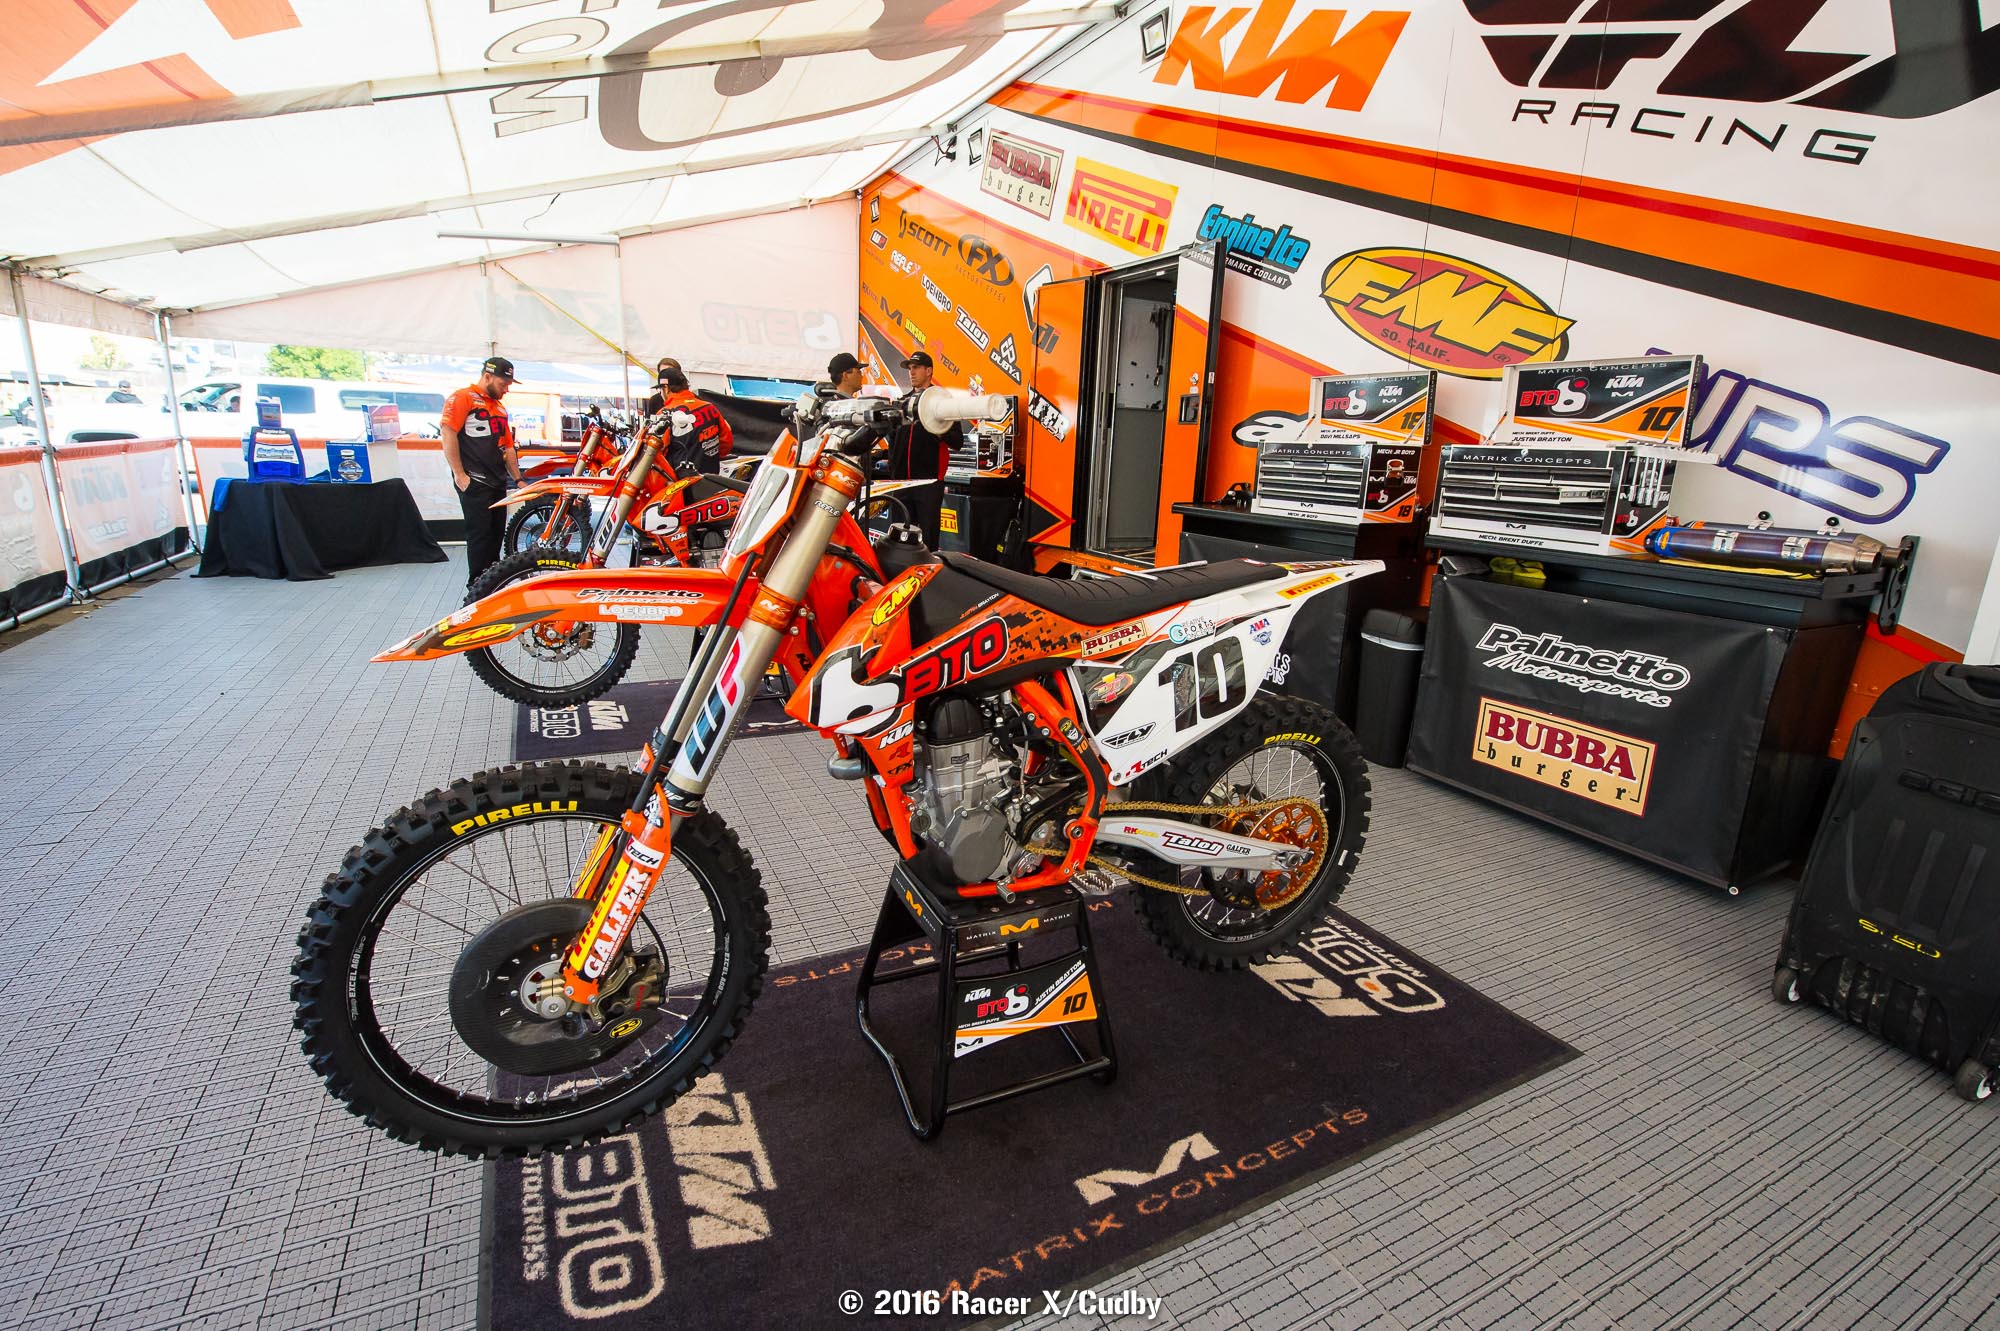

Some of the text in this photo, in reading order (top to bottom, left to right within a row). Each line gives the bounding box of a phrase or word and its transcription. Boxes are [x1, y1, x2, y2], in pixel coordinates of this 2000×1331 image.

[1153, 0, 1411, 113] KTM
[1511, 98, 1878, 165] RACING
[989, 139, 1052, 189] BUBBA
[986, 174, 1048, 208] burger
[1067, 169, 1173, 252] PIRELLI
[906, 222, 953, 257] SCOTT
[1199, 205, 1309, 268] Engine Ice
[1253, 267, 1288, 286] COOLANT
[922, 275, 952, 312] LOENBRO
[1320, 255, 1578, 358] FMF
[1380, 328, 1451, 363] SO. CALIF.
[991, 350, 1021, 384] DUBYA
[1537, 362, 1668, 375] MATRIX CONCEPTS
[1379, 385, 1404, 397] KTM
[1604, 374, 1645, 389] KTM
[1519, 389, 1560, 407] BTO
[1638, 406, 1685, 432] 10
[1463, 454, 1592, 465] MATRIX CONCEPTS
[680, 499, 729, 526] BTO
[1396, 504, 1412, 518] 18
[1498, 536, 1520, 544] BRENT
[577, 587, 703, 598] Palmetto
[874, 576, 921, 624] FMF
[599, 604, 683, 617] LOENBRO
[1085, 624, 1142, 651] BUBBA
[1249, 618, 1271, 635] AMA
[903, 620, 1008, 702] BTO
[1476, 622, 1691, 691] Palmetto
[1158, 636, 1247, 734] 10
[1483, 653, 1672, 708] Motorsports
[1076, 739, 1089, 754] 10
[1108, 723, 1156, 746] FLY
[1263, 732, 1322, 746] PIRELLI
[1485, 709, 1637, 782] BUBBA
[1486, 742, 1628, 802] burger
[450, 800, 578, 837] PIRELLI
[1162, 832, 1224, 855] Talon
[1226, 843, 1252, 855] GALFER
[583, 867, 653, 979] GALFER
[966, 930, 997, 940] MATRIX
[1043, 913, 1072, 923] MATRIX
[964, 987, 992, 1003] KTM
[1035, 959, 1082, 1006] JUSTIN BRAYTON
[977, 996, 1008, 1018] BTO
[1062, 991, 1088, 1016] 10
[1135, 1107, 1369, 1215] CONCEPTS
